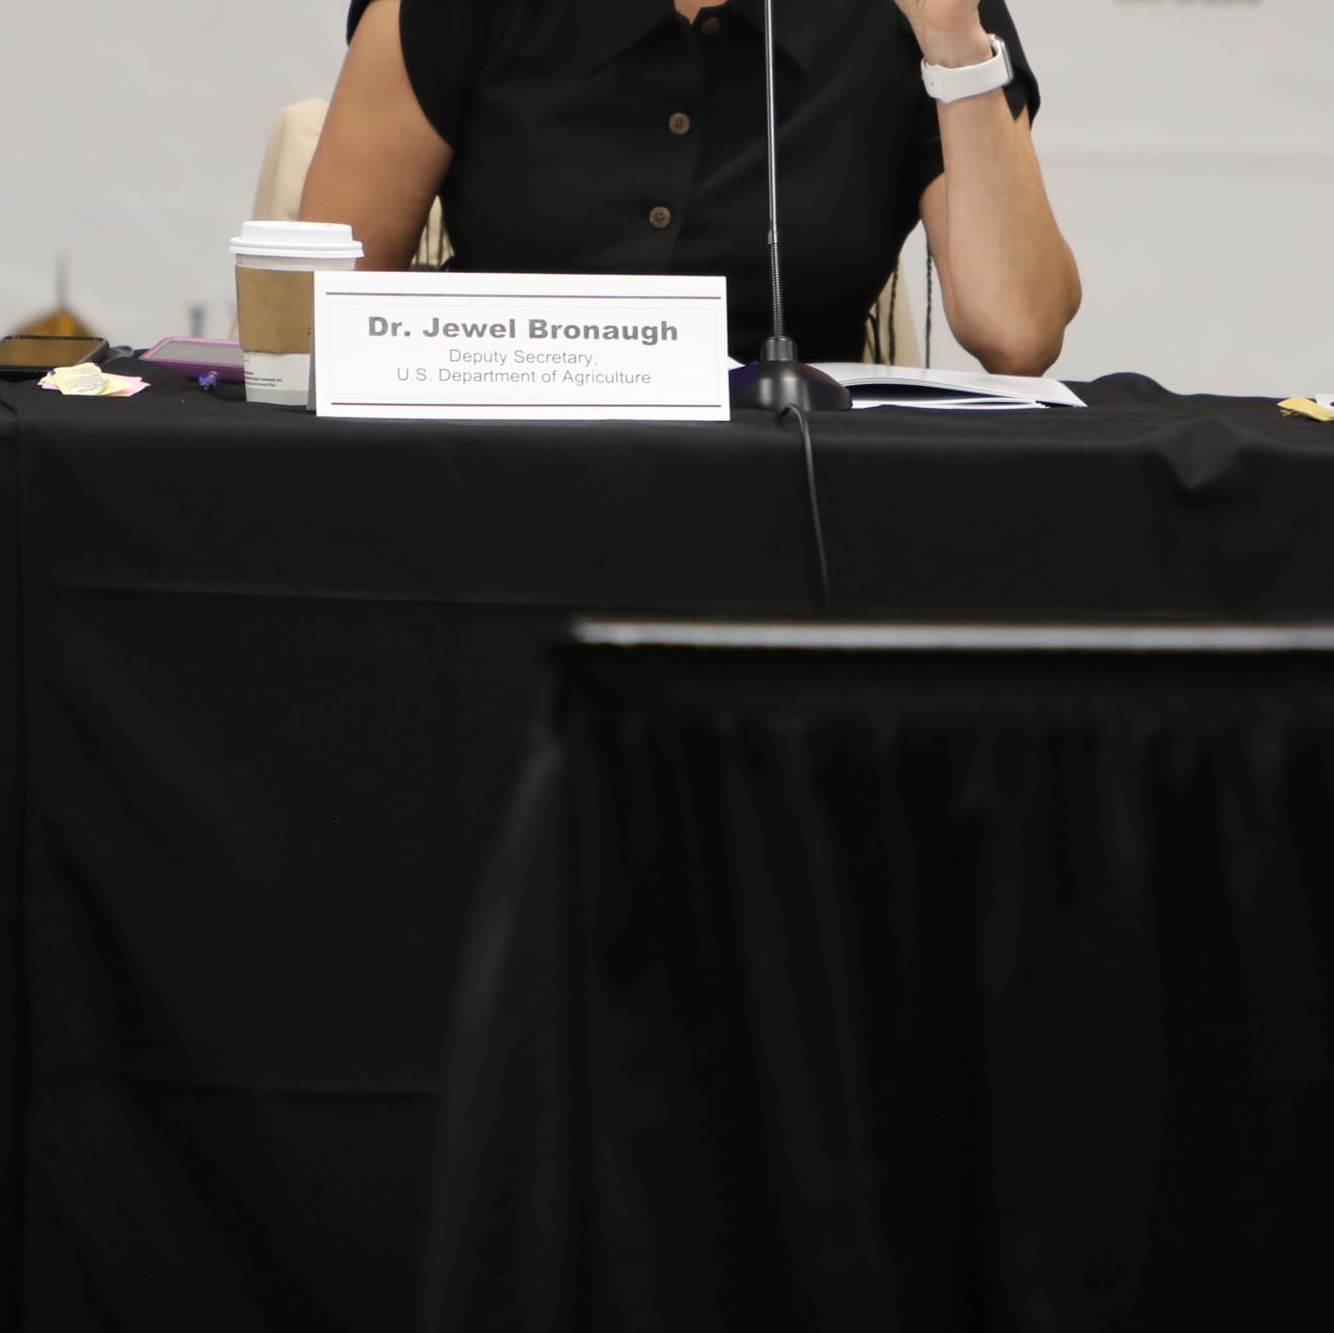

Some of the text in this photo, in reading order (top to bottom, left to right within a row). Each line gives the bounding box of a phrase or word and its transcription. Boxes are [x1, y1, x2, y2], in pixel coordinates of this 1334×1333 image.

[367, 315, 679, 347] Dr. Jewel Bronaugh
[449, 348, 598, 367] Deputy Secretary,
[396, 367, 652, 386] U.S. Department of Agriculture
